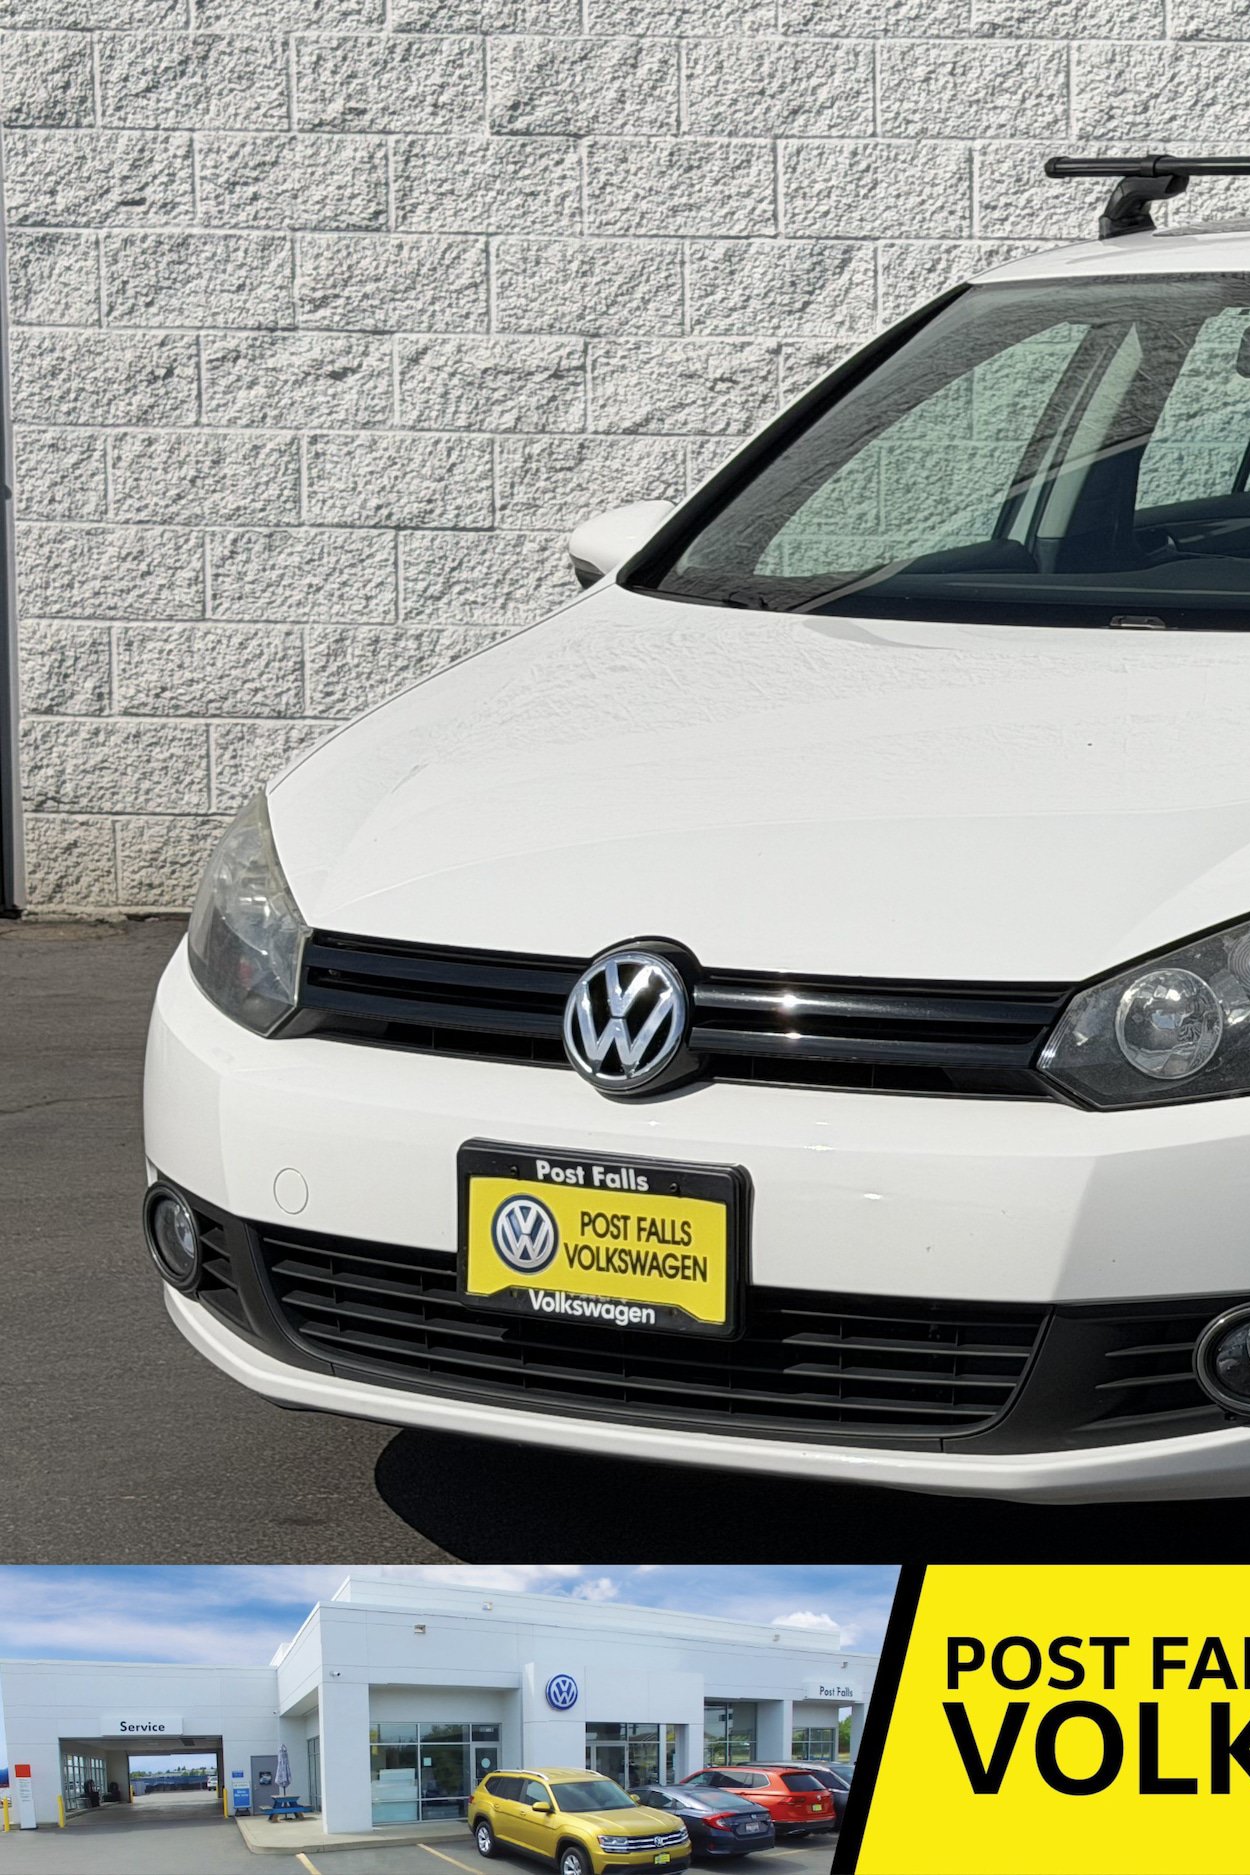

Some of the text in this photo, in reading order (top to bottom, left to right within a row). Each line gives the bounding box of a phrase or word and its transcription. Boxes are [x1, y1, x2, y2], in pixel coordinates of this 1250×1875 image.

[569, 956, 682, 1078] VW
[535, 1160, 649, 1191] Post Falls
[494, 1197, 557, 1270] VW
[580, 1211, 692, 1246] POST FALLS
[564, 1243, 707, 1282] VOLKSWAGEN
[528, 1289, 656, 1326] Volkswagen
[819, 1685, 853, 1697] Post Falls
[119, 1721, 165, 1732] Service
